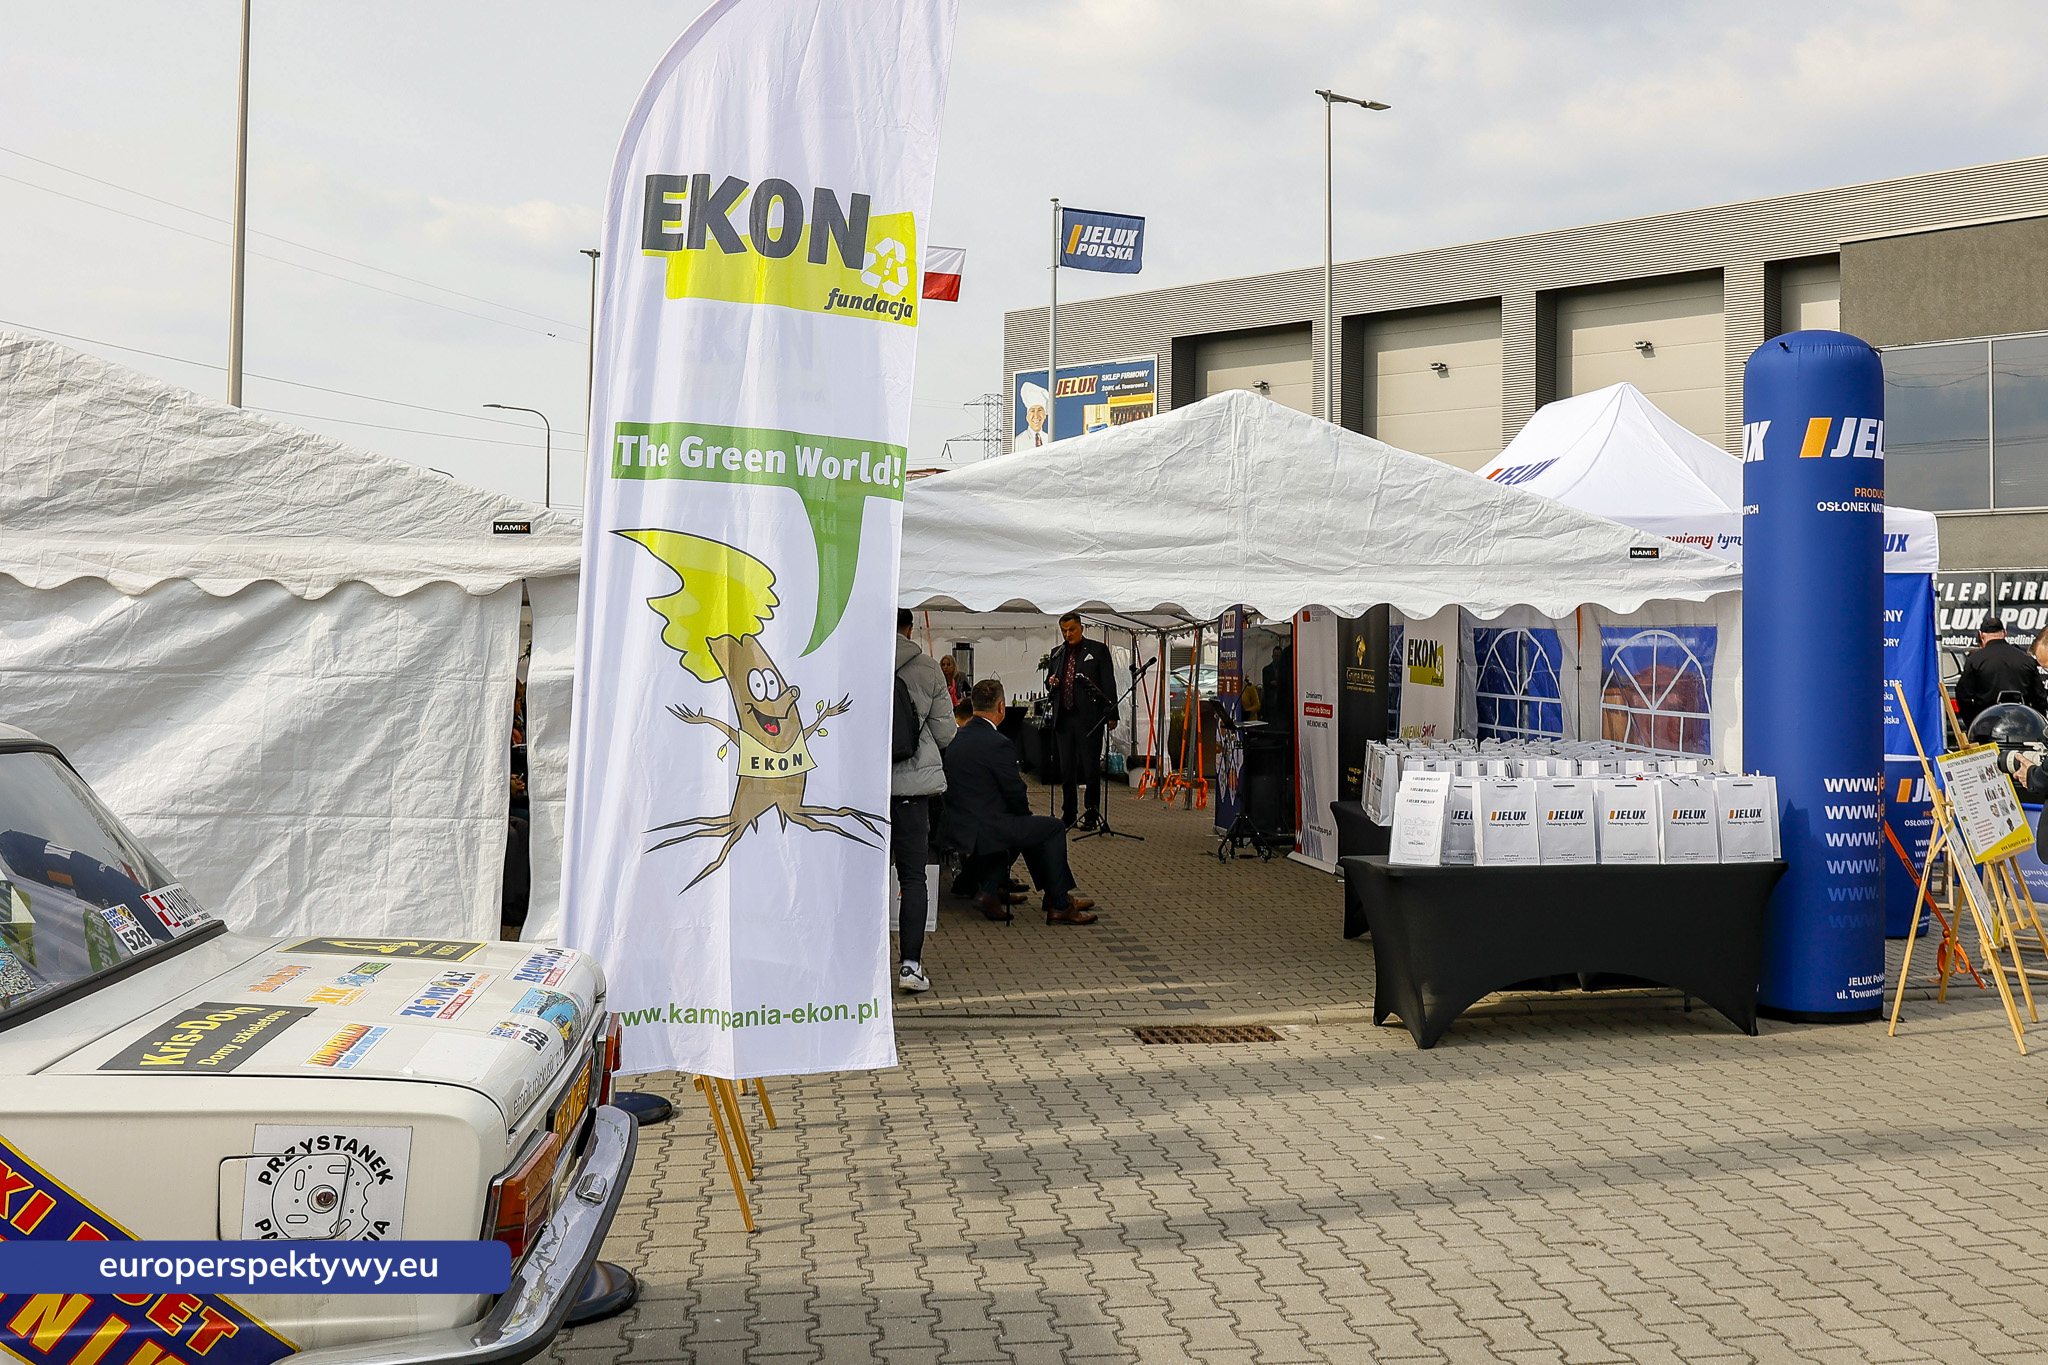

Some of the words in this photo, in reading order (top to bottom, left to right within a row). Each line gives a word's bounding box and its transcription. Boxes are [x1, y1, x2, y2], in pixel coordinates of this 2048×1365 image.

[641, 173, 871, 270] EKON
[1081, 225, 1138, 247] JELUX
[1076, 243, 1134, 261] POLSKA
[824, 287, 913, 320] fundacja
[1055, 375, 1098, 398] JELUX
[1101, 373, 1120, 382] SKLEP
[1120, 370, 1150, 380] FIRMOWY
[617, 435, 669, 467] The
[680, 436, 787, 473] Green
[795, 445, 902, 489] World!
[1817, 501, 1870, 512] OSŁONEK
[1632, 549, 1657, 557] NAMIX
[1408, 639, 1437, 668] EKON
[751, 753, 804, 773] EKON
[1497, 812, 1526, 820] JELUX
[1554, 810, 1584, 820] JELUX
[1616, 810, 1646, 819] JELUX
[1678, 810, 1706, 819] JELUX
[1735, 809, 1762, 818] JELUX
[122, 928, 152, 950] 528
[1848, 977, 1872, 986] JELUX
[1837, 990, 1848, 999] ul.
[1850, 986, 1882, 998] Towarowa
[619, 998, 879, 1031] ww.kampania-ekon.pl
[139, 1006, 266, 1065] Kris-Dom
[197, 1043, 242, 1066] Domy
[232, 1010, 290, 1043] szkieletowe
[521, 1028, 550, 1052] 528
[258, 1135, 394, 1186] PRZYSTANEK
